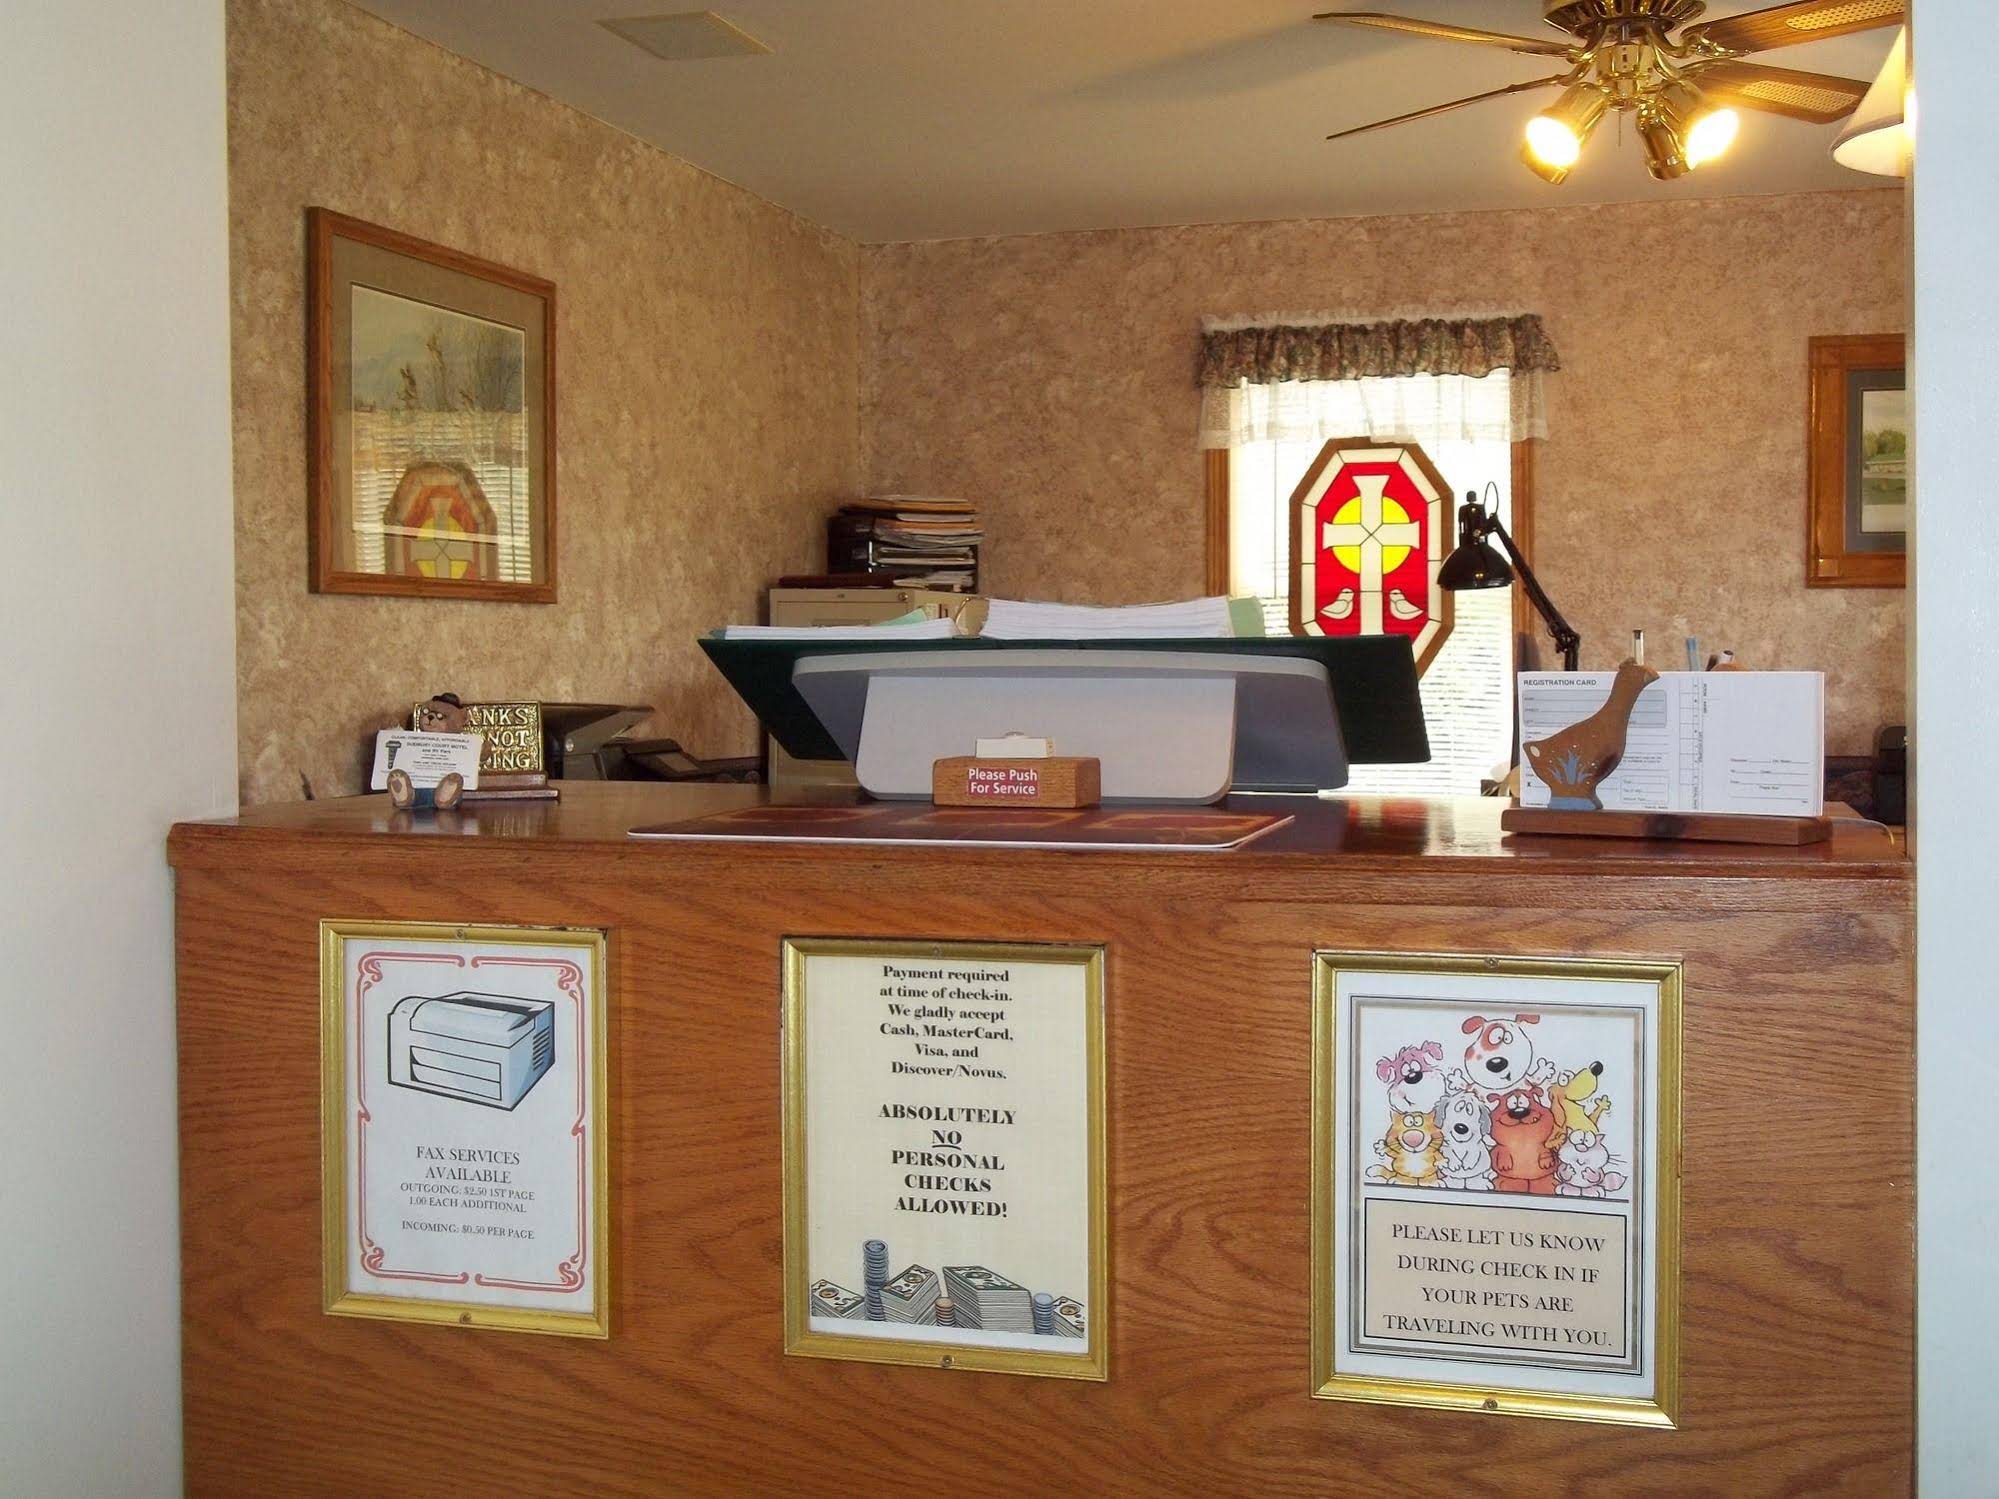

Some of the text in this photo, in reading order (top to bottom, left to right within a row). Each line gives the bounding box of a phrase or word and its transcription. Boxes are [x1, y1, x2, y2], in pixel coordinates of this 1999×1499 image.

[488, 730, 529, 747] NOT
[968, 768, 1038, 782] Please Push
[970, 782, 1036, 795] For Service
[883, 965, 1009, 984] Payment required
[879, 986, 1013, 1001] at time of check-in.
[888, 1003, 1006, 1023] We gladly accept
[879, 1022, 1014, 1041] Cash, MasterCard,
[914, 1043, 979, 1058] Visa, and
[891, 1061, 1008, 1080] Discover/Novus.
[878, 1103, 1017, 1125] ABSOLUTELY
[931, 1129, 963, 1146] NO
[416, 1145, 521, 1166] FAX SERVICES
[891, 1150, 1005, 1171] PERSONAL
[425, 1165, 512, 1184] AVAILABLE
[904, 1173, 992, 1193] CHECKS
[400, 1182, 536, 1201] OUTGOING: $2.50 1ST PAGE
[409, 1196, 527, 1213] 1.00 EACH ADDITIONAL
[894, 1196, 1008, 1218] ALLOWED!
[401, 1220, 535, 1240] INCOMING: $0.50 PER PAGE
[1392, 1223, 1606, 1252] PLEASE LET US KNOW
[1397, 1254, 1600, 1284] DURING CHECK IN IF
[1421, 1286, 1574, 1313] YOUR PETS ARE
[1382, 1314, 1613, 1347] TRAVELING WITH YOU.
